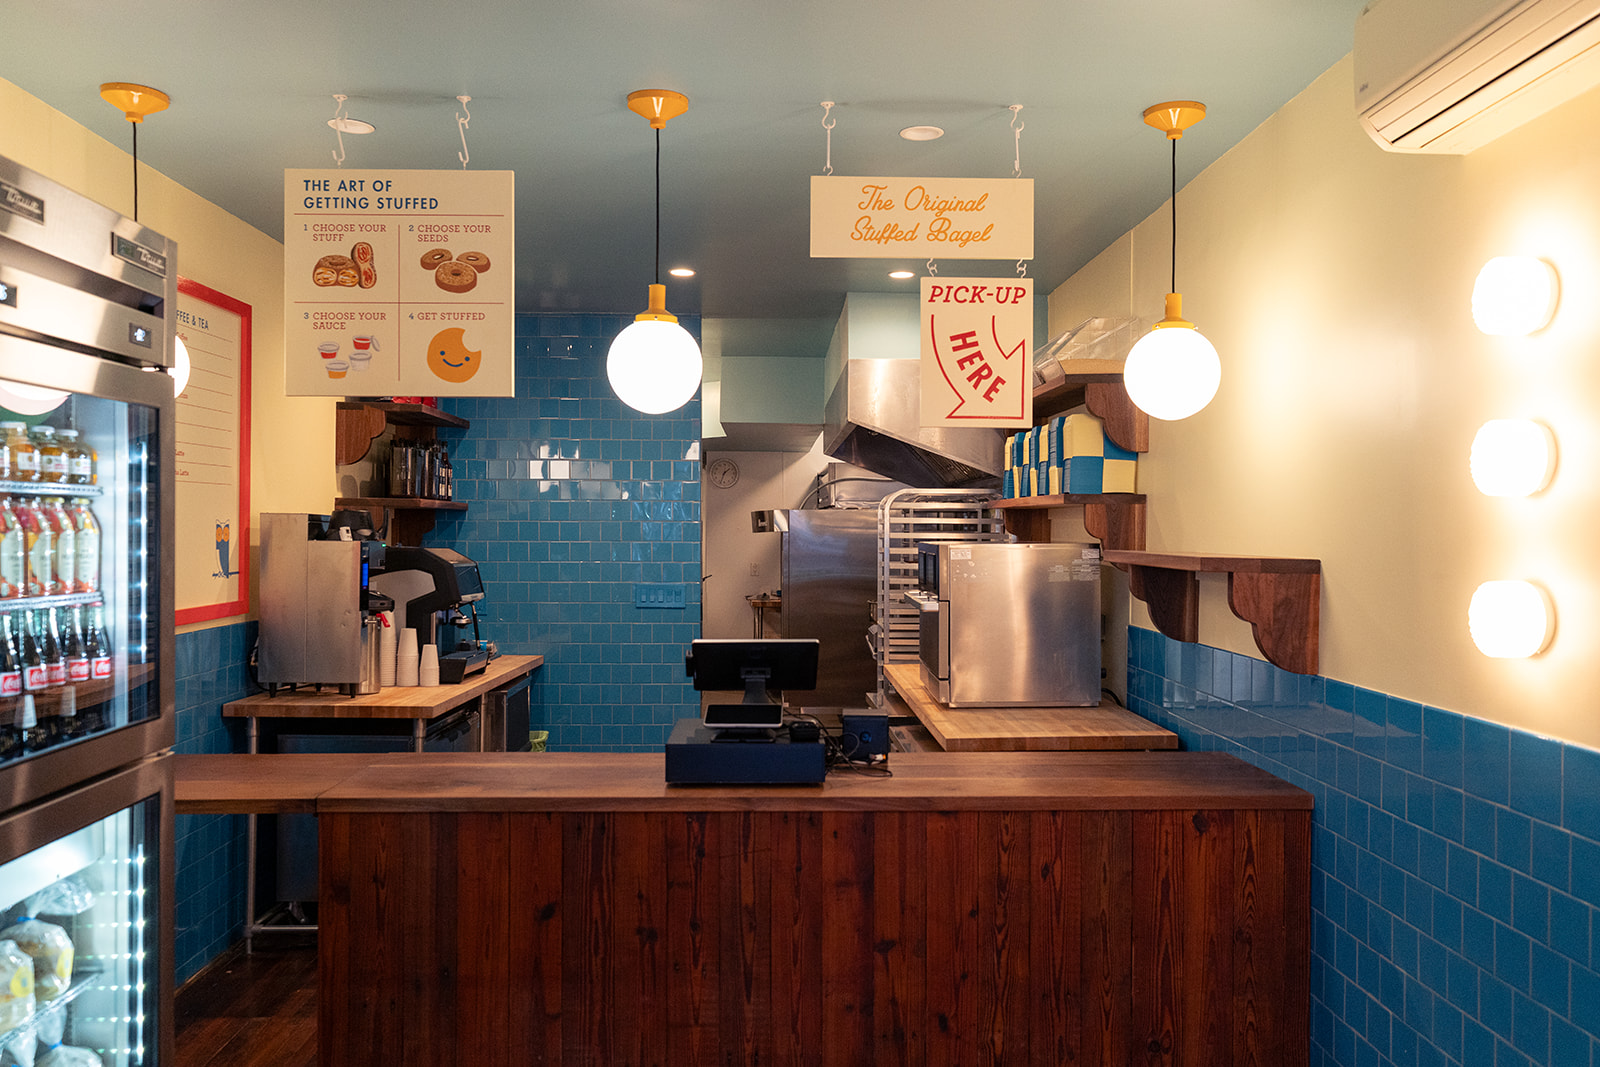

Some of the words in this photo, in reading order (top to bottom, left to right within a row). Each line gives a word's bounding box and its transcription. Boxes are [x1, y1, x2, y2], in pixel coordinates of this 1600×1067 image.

[304, 180, 330, 192] THE
[338, 180, 366, 192] ART
[372, 180, 393, 192] OF
[303, 197, 370, 209] GETTING
[376, 197, 439, 210] STUFFED
[858, 184, 896, 211] The
[904, 185, 990, 217] Original
[312, 224, 356, 233] CHOOSE
[359, 224, 387, 233] YOUR
[417, 224, 461, 233] CHOOSE
[463, 225, 492, 233] YOUR
[850, 216, 921, 245] Stuffed
[926, 217, 995, 249] Bagel
[312, 234, 345, 242] STUFF
[417, 234, 449, 243] SEEDS
[928, 285, 1027, 304] PICK-UP
[304, 312, 309, 320] 3
[312, 312, 356, 321] CHOOSE
[359, 313, 387, 321] YOUR
[417, 312, 438, 321] GET
[440, 313, 486, 321] STUFFED
[192, 315, 196, 326] &
[198, 317, 209, 330] TEA
[312, 322, 346, 330] SAUCE
[950, 330, 1007, 403] HERE
